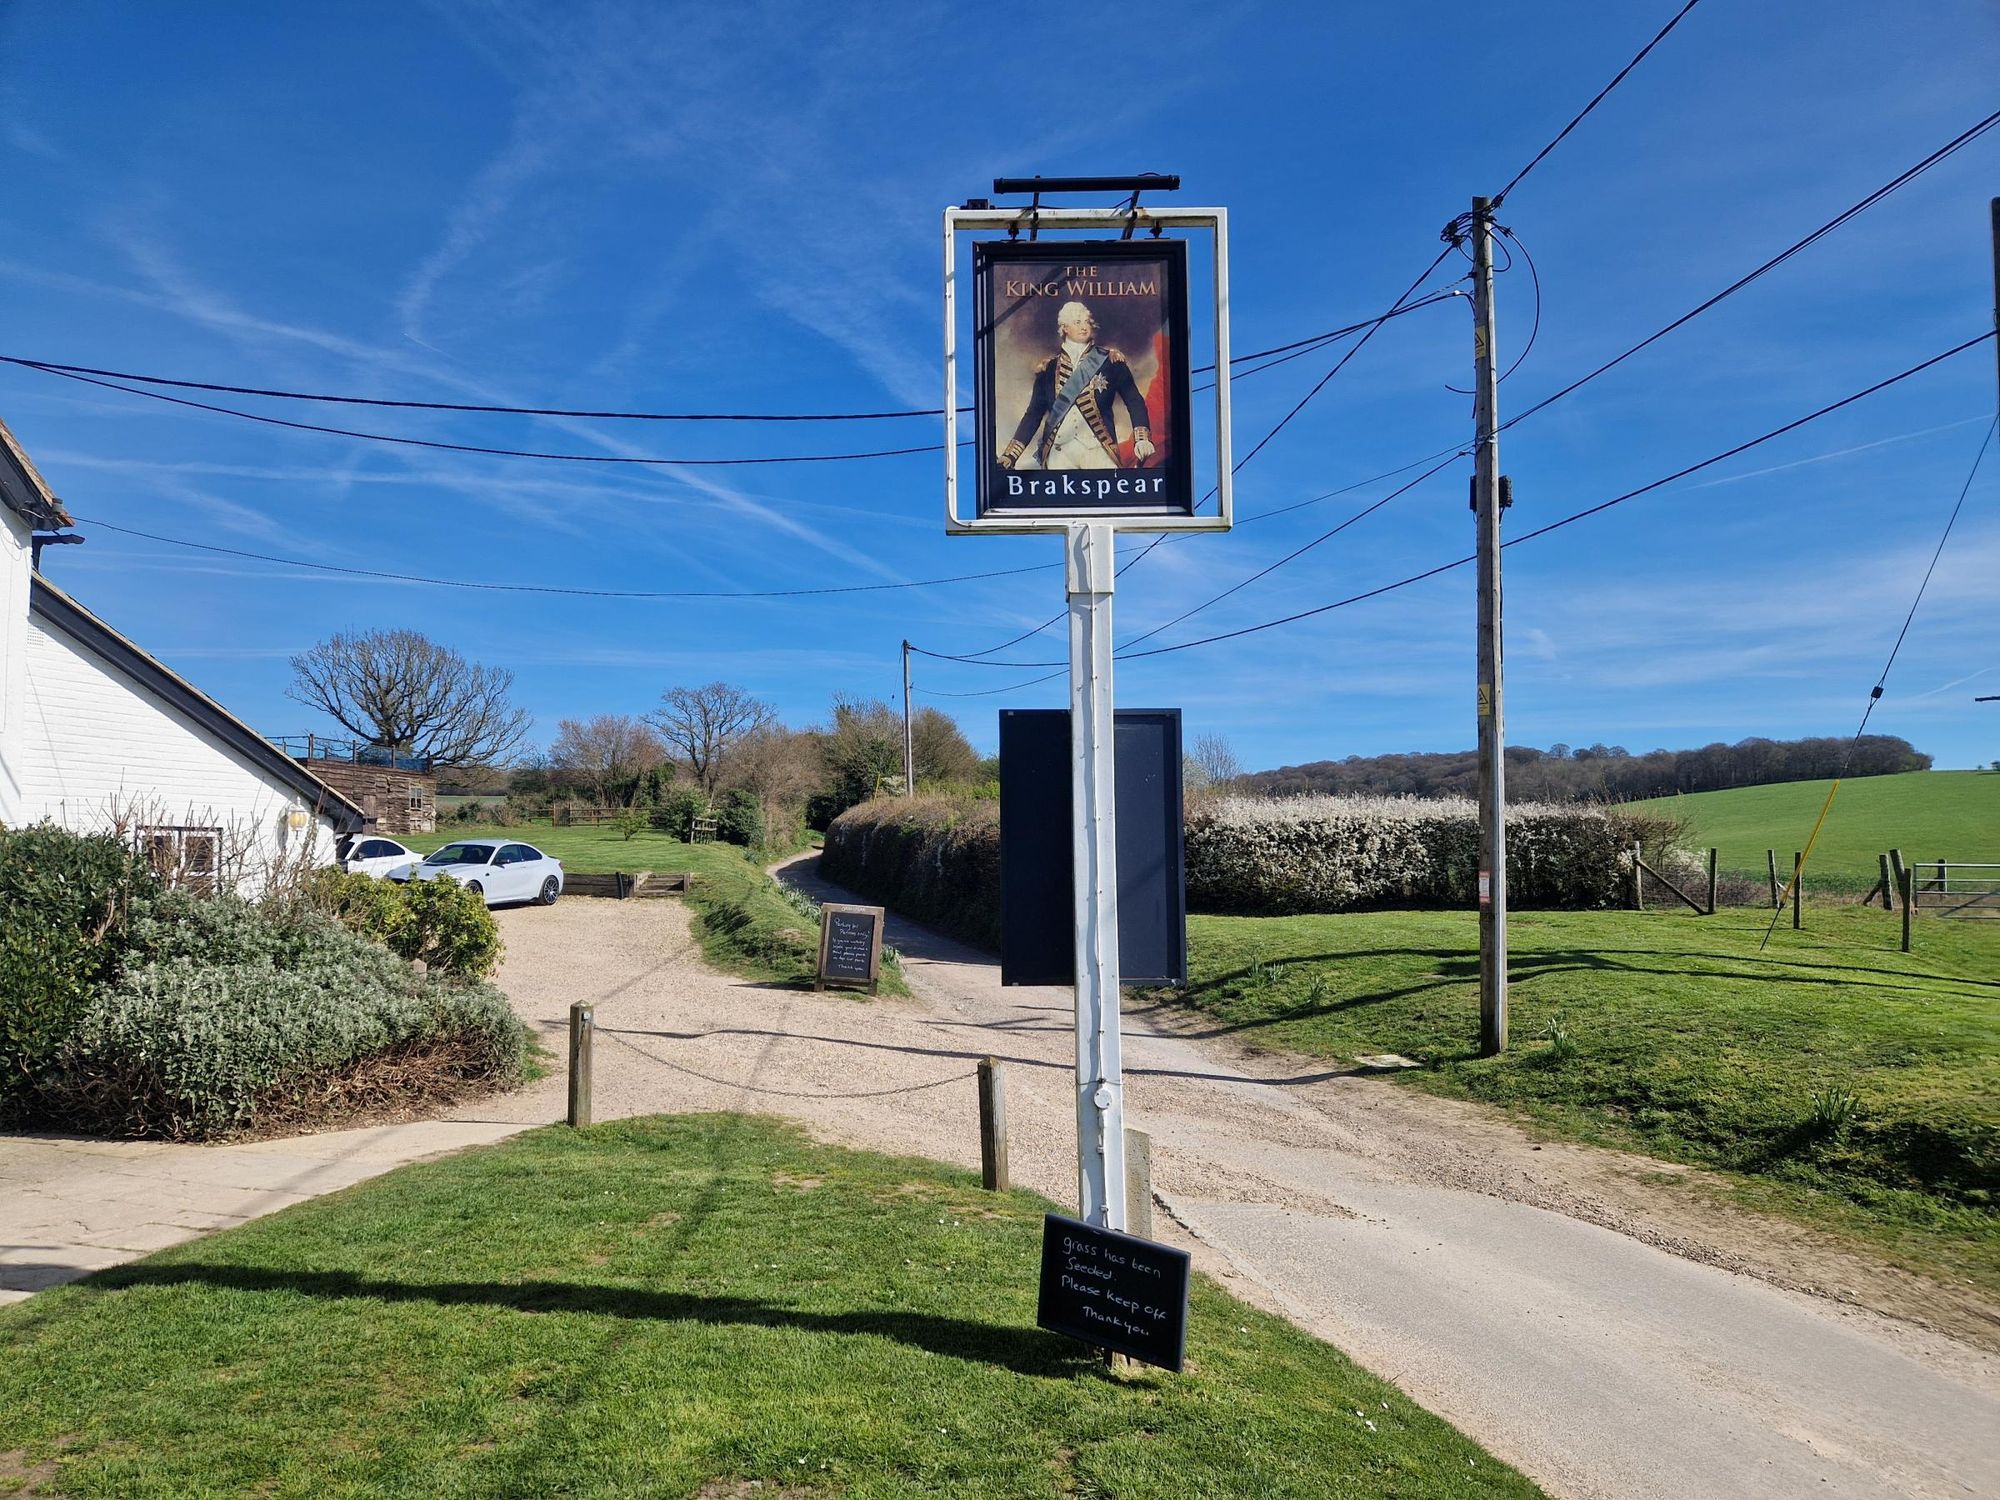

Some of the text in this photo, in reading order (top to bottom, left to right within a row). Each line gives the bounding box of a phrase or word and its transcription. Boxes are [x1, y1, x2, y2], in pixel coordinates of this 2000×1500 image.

[1065, 266, 1098, 277] THE
[1006, 280, 1156, 296] KING WILLIAM
[1007, 475, 1163, 499] Brakspear
[1063, 1237, 1161, 1279] grass has been
[1061, 1274, 1101, 1296] Please
